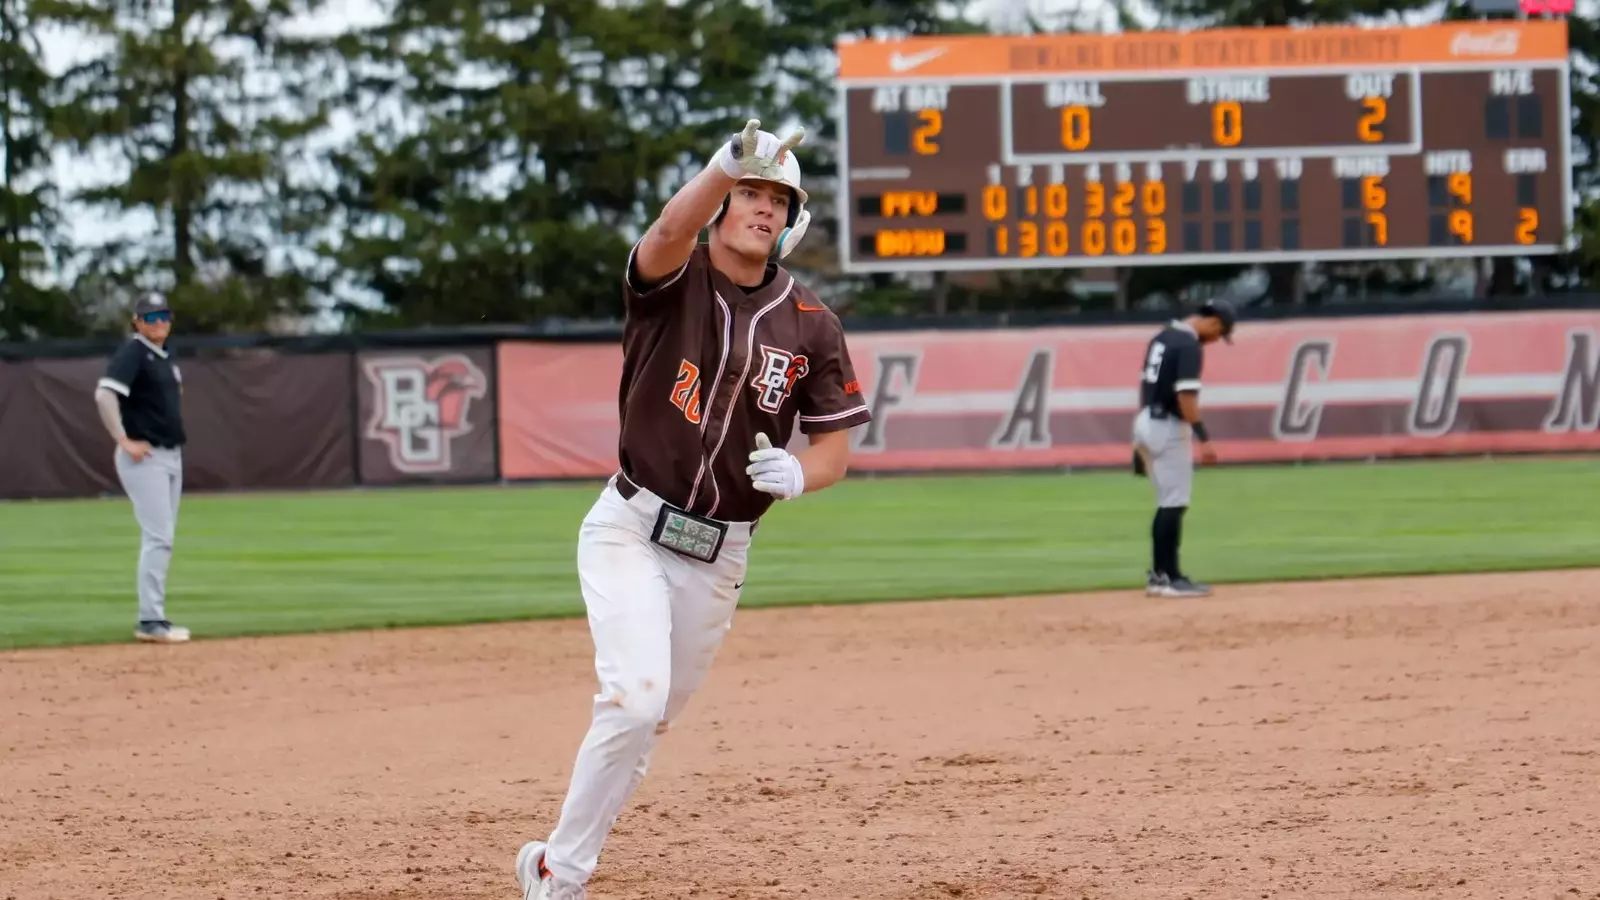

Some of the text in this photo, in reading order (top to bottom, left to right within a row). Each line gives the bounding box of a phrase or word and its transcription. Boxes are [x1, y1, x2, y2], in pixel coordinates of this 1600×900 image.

[1112, 41, 1181, 68] GREEN
[1191, 38, 1258, 67] STATE
[1269, 33, 1401, 64] UNIVERSITY
[872, 84, 950, 112] AT BAT
[1046, 79, 1106, 107] BALL
[1186, 75, 1270, 104] STRIKE
[1345, 71, 1394, 100] OUT
[912, 108, 943, 155] 2
[1060, 105, 1091, 151] 0
[1212, 100, 1243, 147] 0
[1356, 96, 1388, 142] 2
[987, 162, 1002, 185] 1
[1017, 163, 1033, 186] 2
[1084, 162, 1101, 183] 4
[1184, 159, 1199, 181] 7
[1211, 158, 1228, 181] 8
[1242, 158, 1258, 180] 9
[1274, 157, 1302, 179] 10
[1333, 155, 1391, 177] RUNS
[1424, 150, 1472, 176] HITS
[1504, 148, 1547, 174] ERR
[982, 184, 1007, 220] 0
[1026, 185, 1038, 216] 1
[1044, 182, 1069, 219] 0
[1085, 181, 1105, 218] 3
[1111, 180, 1136, 217] 2
[1142, 179, 1166, 216] 0
[1361, 175, 1387, 210] 6
[1448, 172, 1472, 205] 9
[996, 223, 1009, 255] 1
[1018, 220, 1039, 258] 3
[1044, 219, 1069, 256] 0
[1082, 219, 1106, 256] 0
[1112, 218, 1137, 255] 0
[1146, 217, 1167, 255] 3
[1366, 211, 1388, 246] 7
[1449, 209, 1473, 244] 9
[1515, 206, 1539, 245] 2
